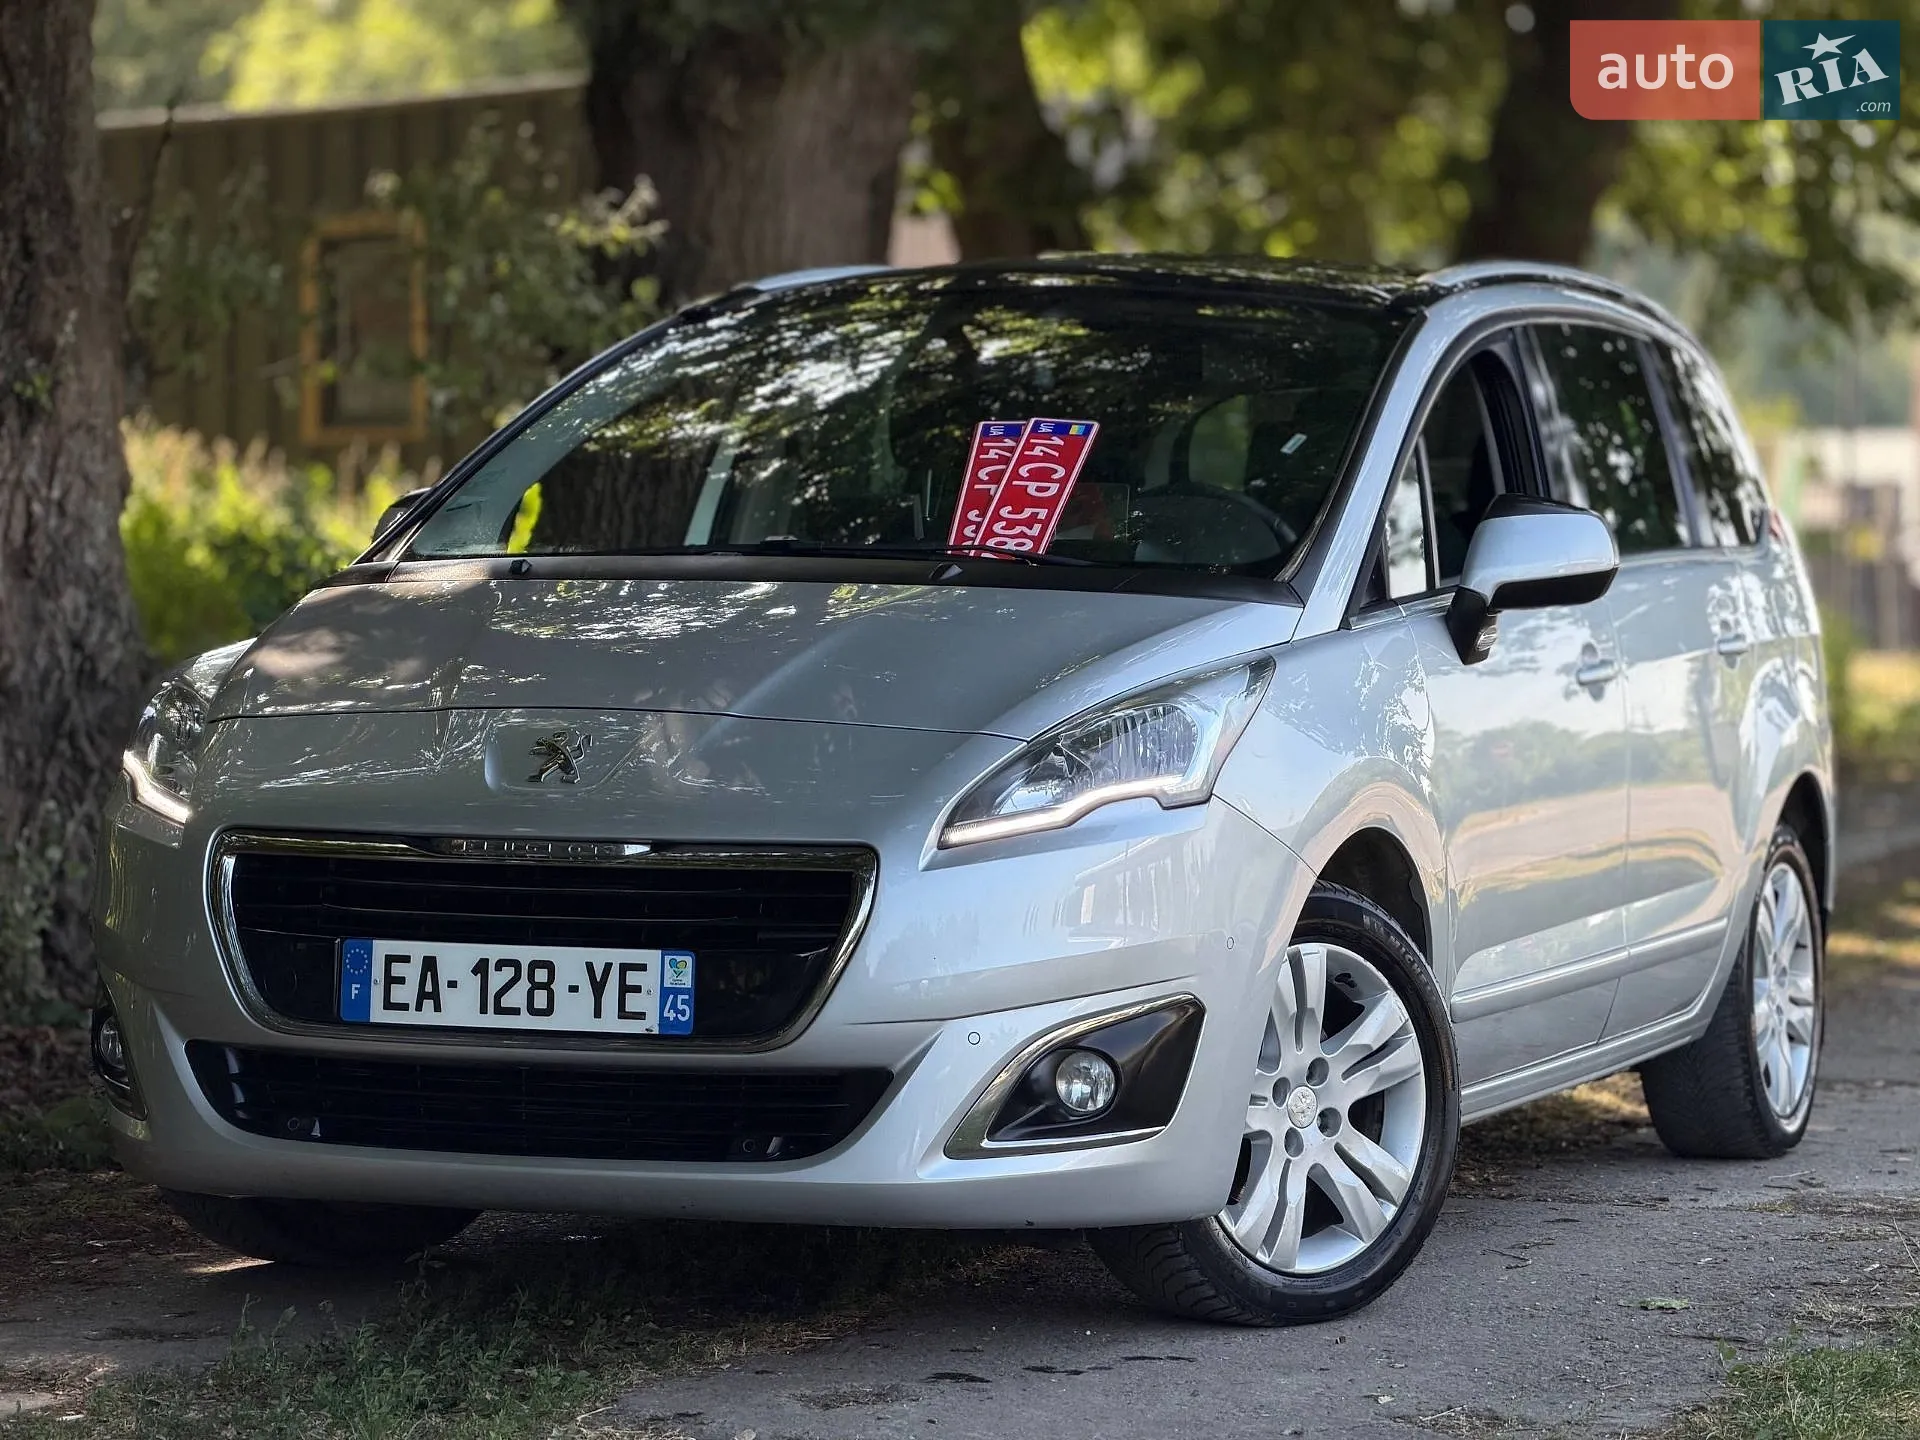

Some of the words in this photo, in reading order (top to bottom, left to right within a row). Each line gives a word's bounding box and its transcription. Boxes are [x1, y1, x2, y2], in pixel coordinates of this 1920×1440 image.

[989, 425, 1005, 436] UA
[1038, 423, 1055, 433] UA
[982, 505, 1049, 559] 538
[351, 983, 361, 1000] F
[382, 953, 648, 1021] EA-128-YE
[663, 994, 690, 1023] 45
